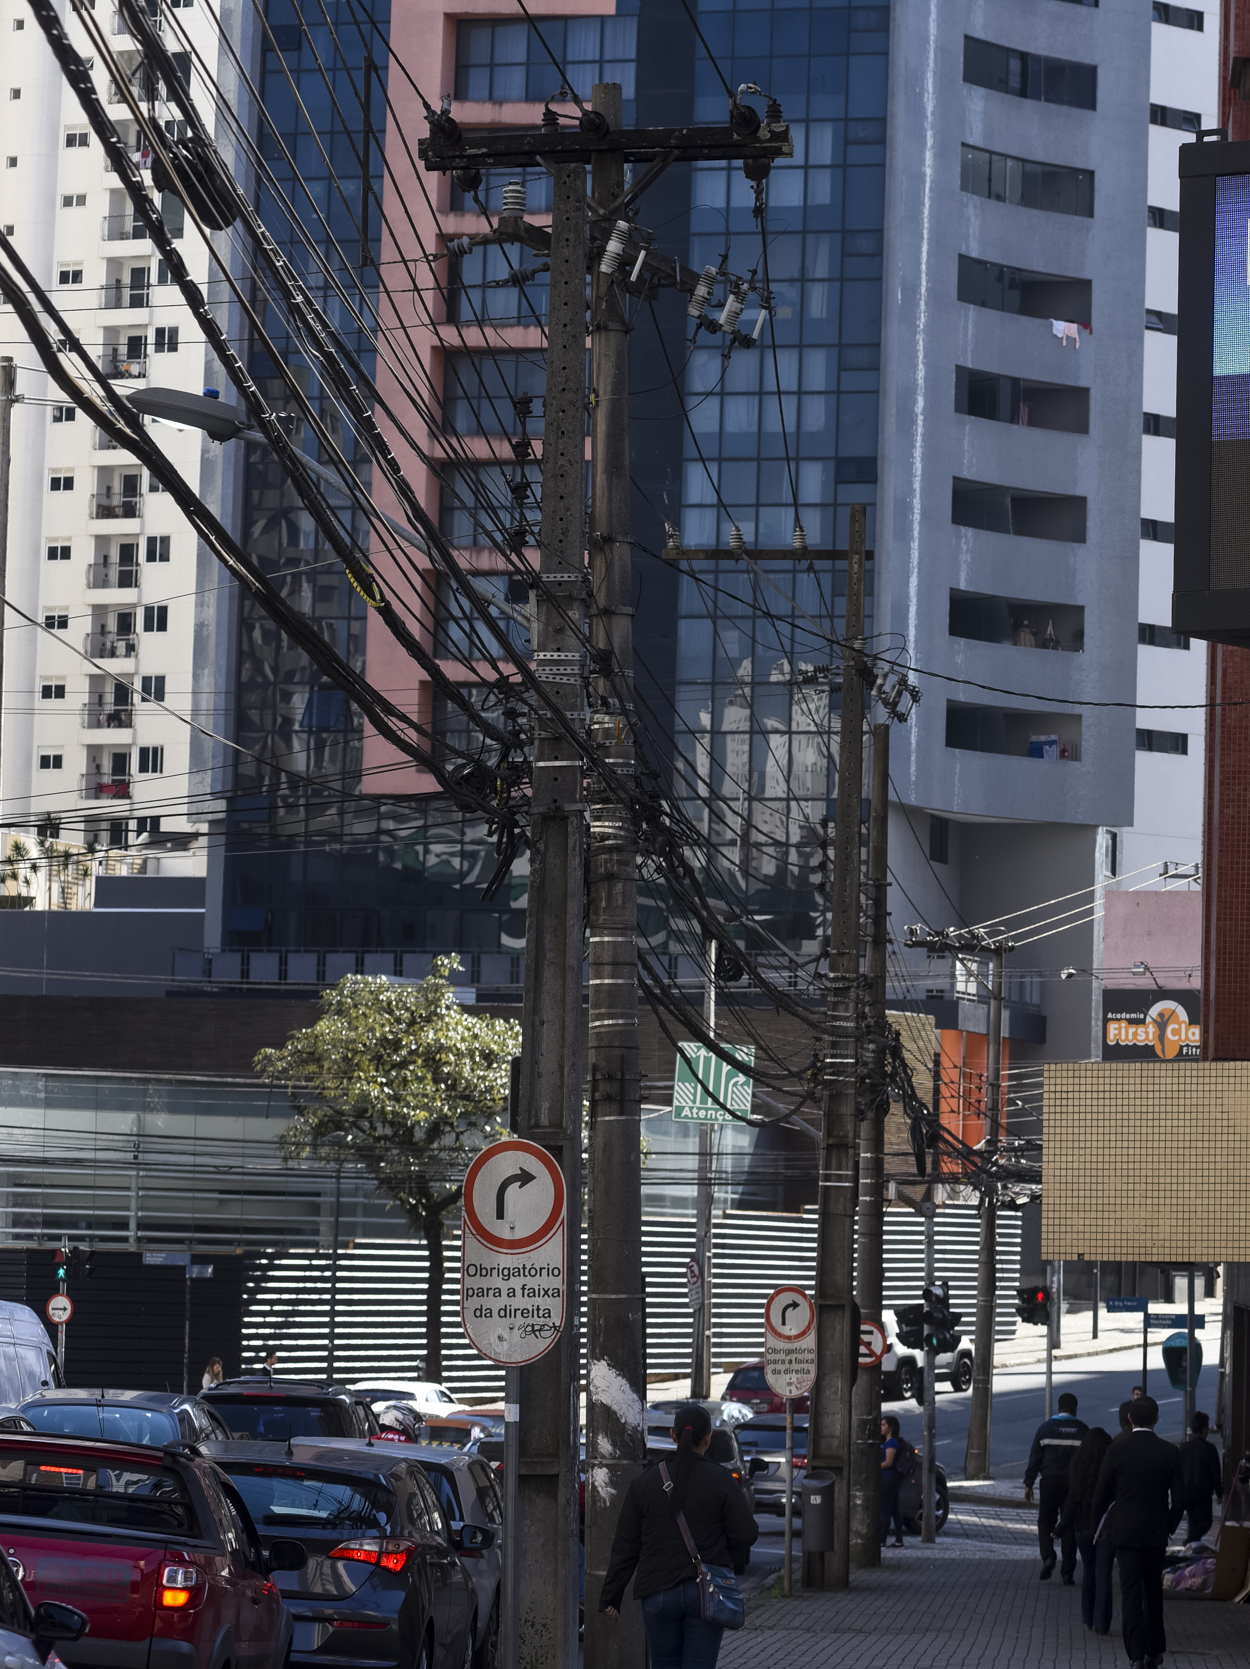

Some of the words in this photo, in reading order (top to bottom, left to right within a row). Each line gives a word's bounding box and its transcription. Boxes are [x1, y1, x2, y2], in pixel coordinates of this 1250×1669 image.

[1109, 1023, 1155, 1041] First
[465, 1263, 562, 1281] Obrigatório
[465, 1286, 502, 1301] para
[506, 1287, 516, 1298] a
[521, 1284, 561, 1298] faixa
[473, 1305, 493, 1319] da
[497, 1305, 552, 1319] direita
[767, 1347, 814, 1356] Obrigatório
[771, 1367, 781, 1375] da
[783, 1367, 810, 1375] direita
